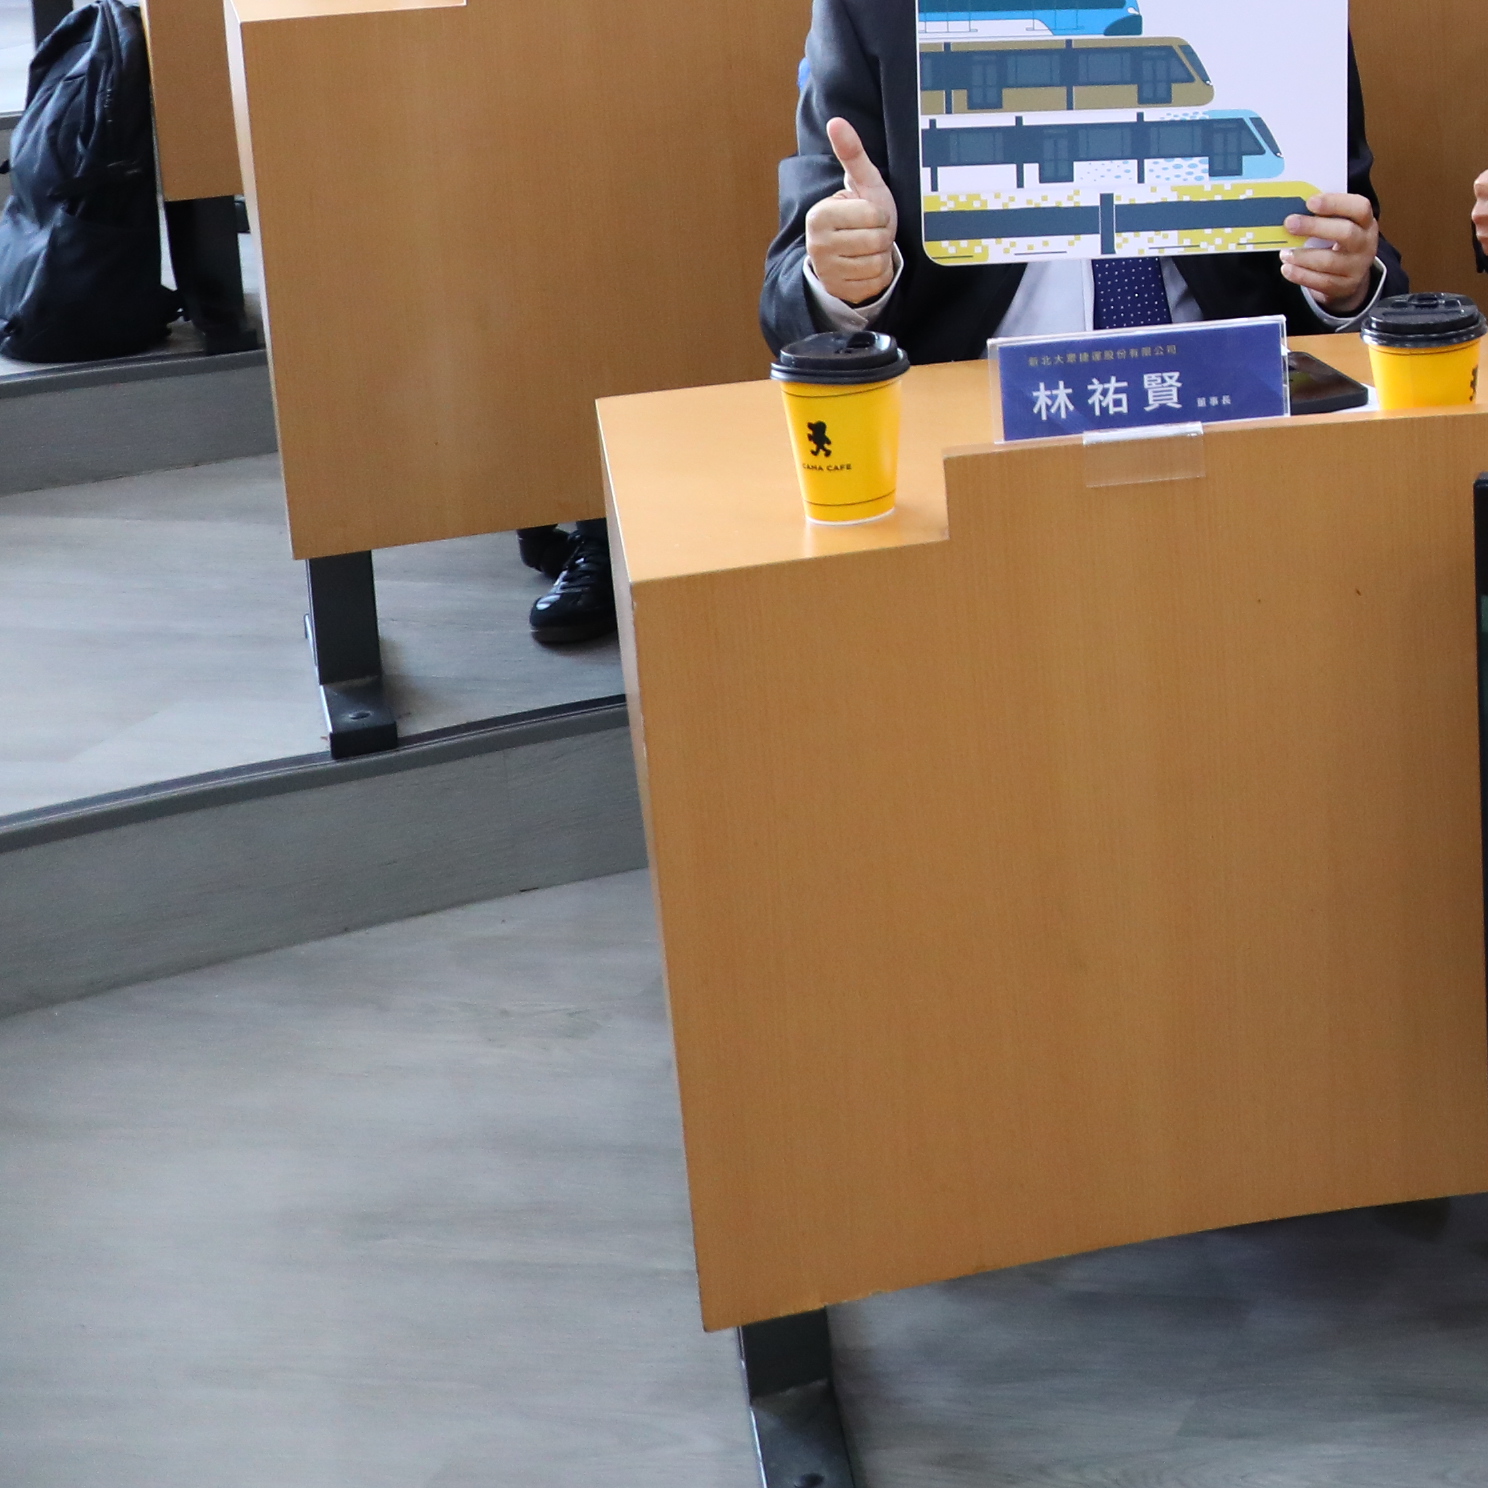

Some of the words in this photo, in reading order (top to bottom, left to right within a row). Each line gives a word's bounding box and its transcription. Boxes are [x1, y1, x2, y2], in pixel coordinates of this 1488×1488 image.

[1032, 371, 1182, 420] 林祐賢
[826, 463, 851, 472] CAFE
